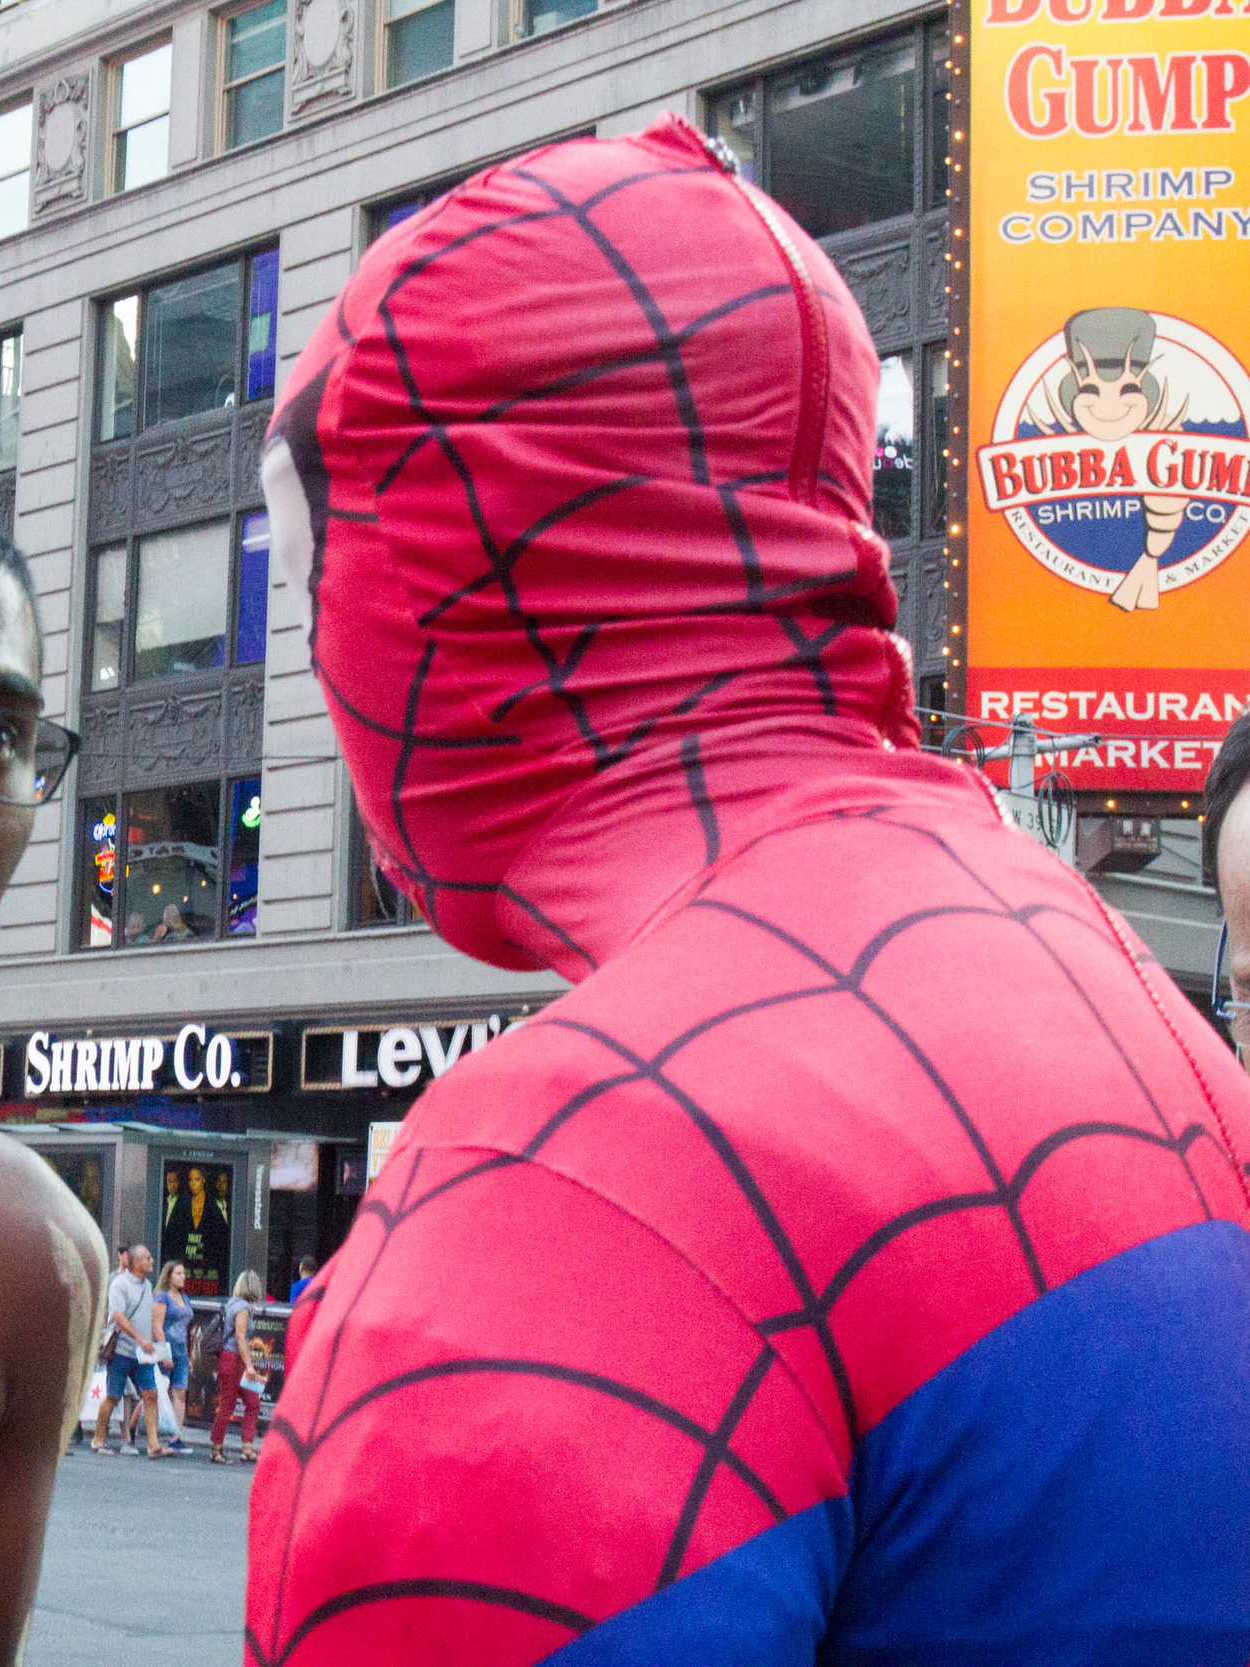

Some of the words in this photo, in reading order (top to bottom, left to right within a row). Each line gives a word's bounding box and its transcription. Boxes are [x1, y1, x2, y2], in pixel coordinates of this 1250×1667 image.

[1006, 43, 1250, 138] GUMP
[1027, 168, 1234, 202] SHRIMP
[989, 444, 1138, 501] BUBBA
[1146, 438, 1250, 496] GUM
[1037, 499, 1141, 525] SHRIMP
[1011, 508, 1115, 589] RESTAURANT
[26, 1031, 164, 1094] SHRIMP
